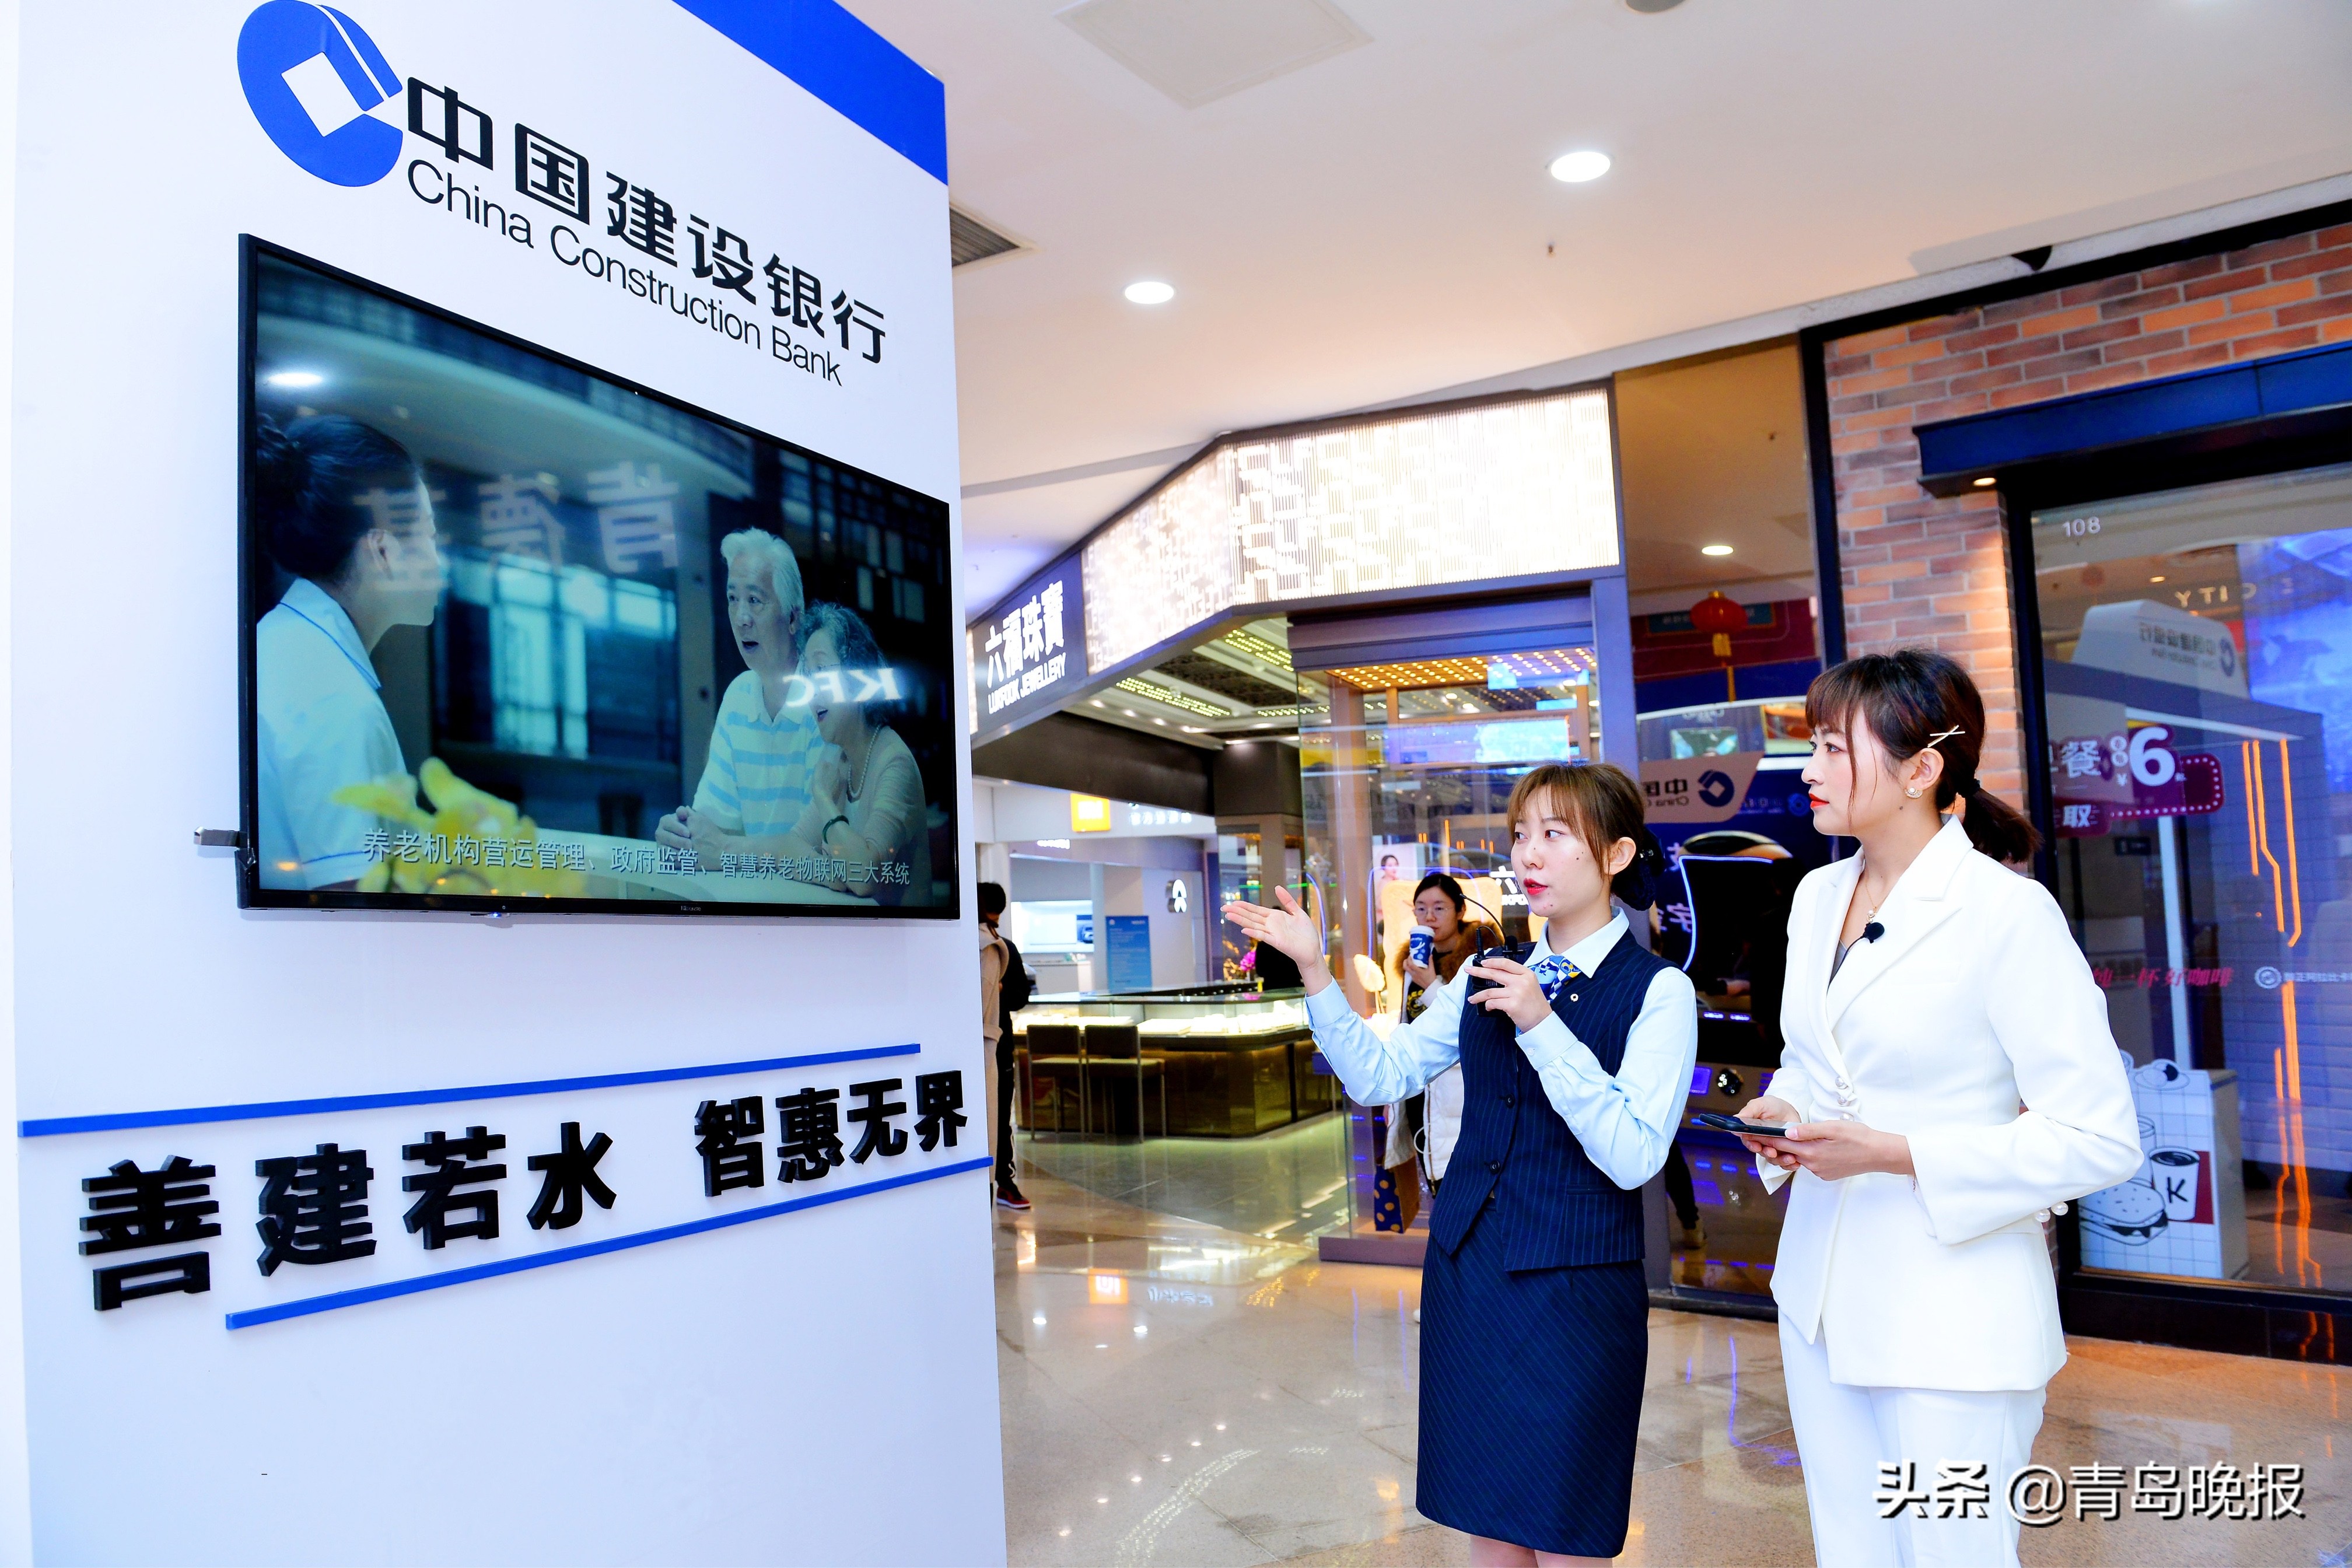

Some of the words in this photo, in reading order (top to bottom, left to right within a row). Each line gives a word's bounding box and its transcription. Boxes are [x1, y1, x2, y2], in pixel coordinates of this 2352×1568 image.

[407, 76, 887, 364] 中国建设银行
[407, 159, 535, 250] China
[550, 225, 762, 350] Construction
[772, 330, 843, 386] Bank
[2062, 516, 2101, 537] 108
[1020, 652, 1066, 698] JEWELLERY
[2129, 726, 2176, 787] 6
[77, 1121, 618, 1312] 善建若水
[692, 1069, 970, 1198] 智惠无界
[2166, 1176, 2188, 1204] K
